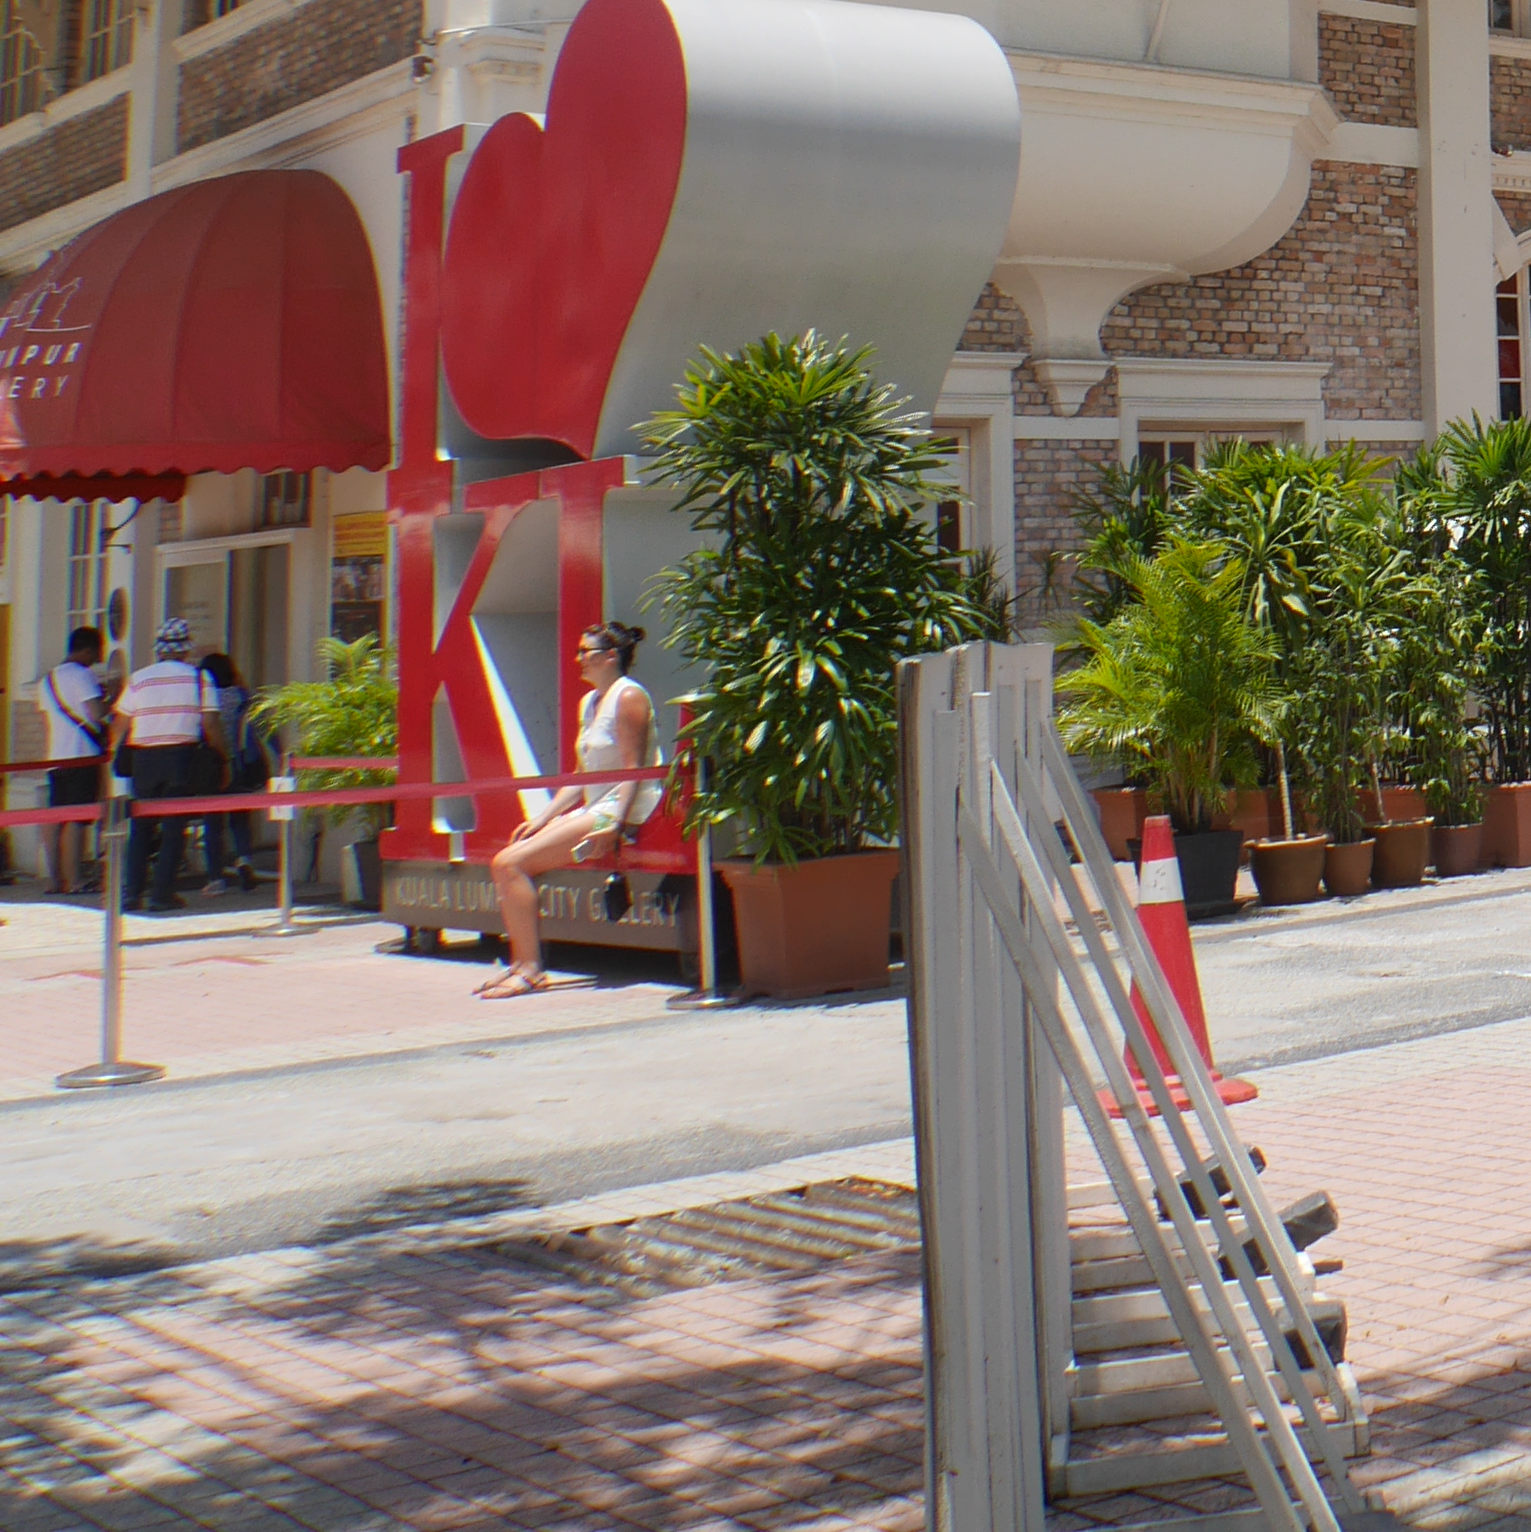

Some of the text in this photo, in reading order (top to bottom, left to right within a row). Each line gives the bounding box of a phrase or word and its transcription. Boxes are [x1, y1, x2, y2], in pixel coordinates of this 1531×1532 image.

[0, 375, 69, 399] ERY
[396, 877, 451, 910] KUALA
[538, 884, 580, 919] CITY
